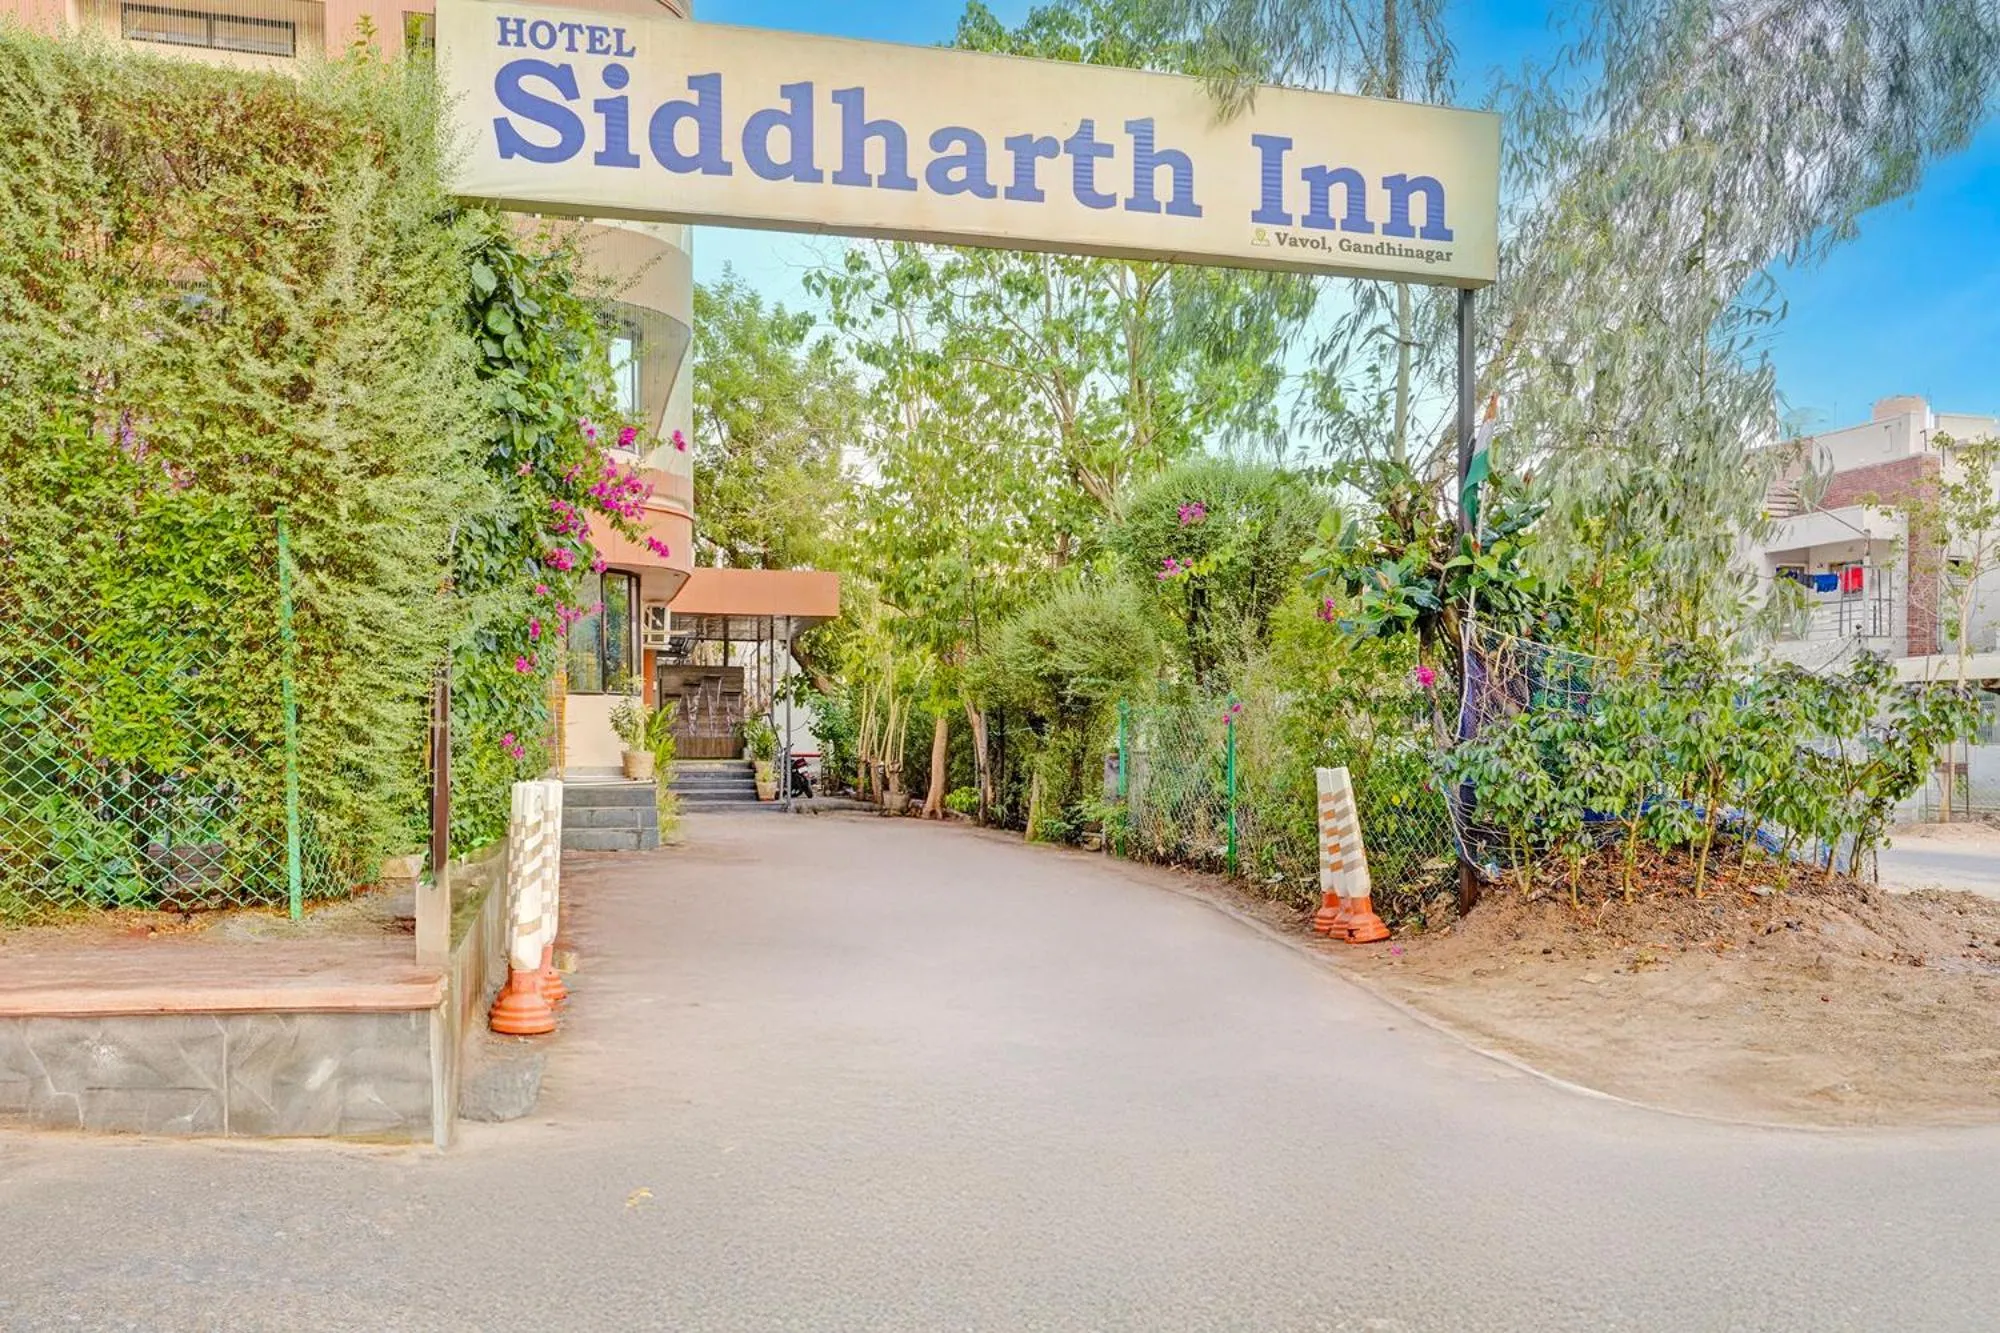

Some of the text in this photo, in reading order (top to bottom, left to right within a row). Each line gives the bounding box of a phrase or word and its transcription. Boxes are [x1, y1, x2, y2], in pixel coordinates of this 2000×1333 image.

[497, 16, 636, 58] HOTEL
[493, 59, 1454, 242] Siddharth Inn
[1275, 231, 1453, 263] Vavol, Gandhinagar
